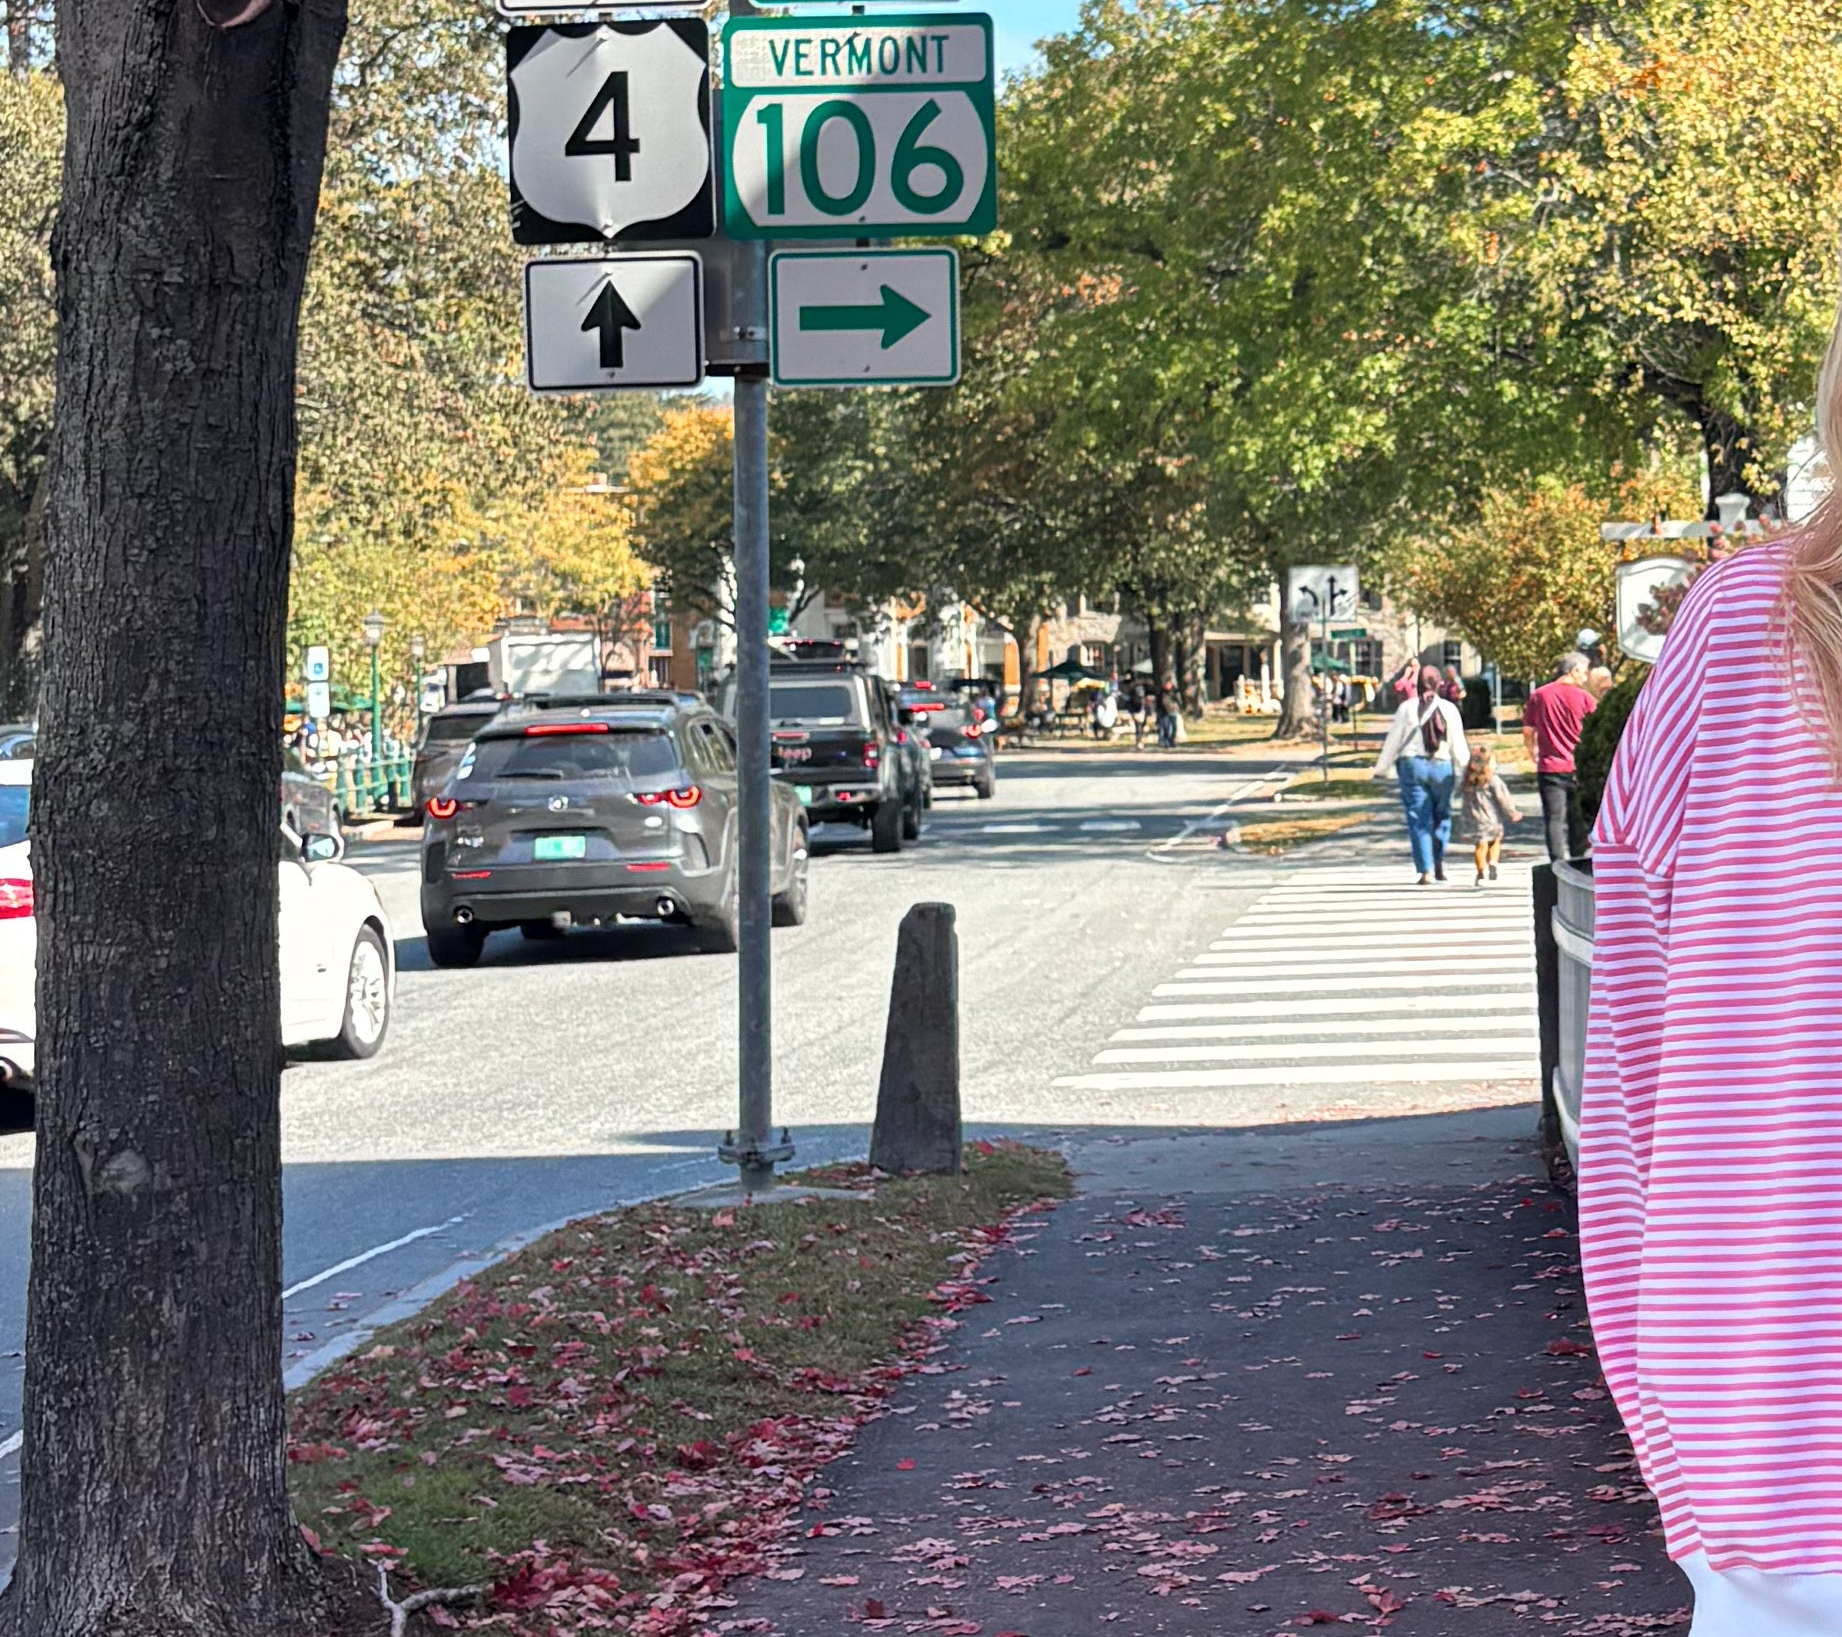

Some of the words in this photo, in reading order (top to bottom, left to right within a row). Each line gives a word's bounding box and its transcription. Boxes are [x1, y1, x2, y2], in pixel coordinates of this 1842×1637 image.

[769, 35, 950, 77] VERMONT
[565, 71, 640, 182] 4
[757, 98, 965, 216] 106
